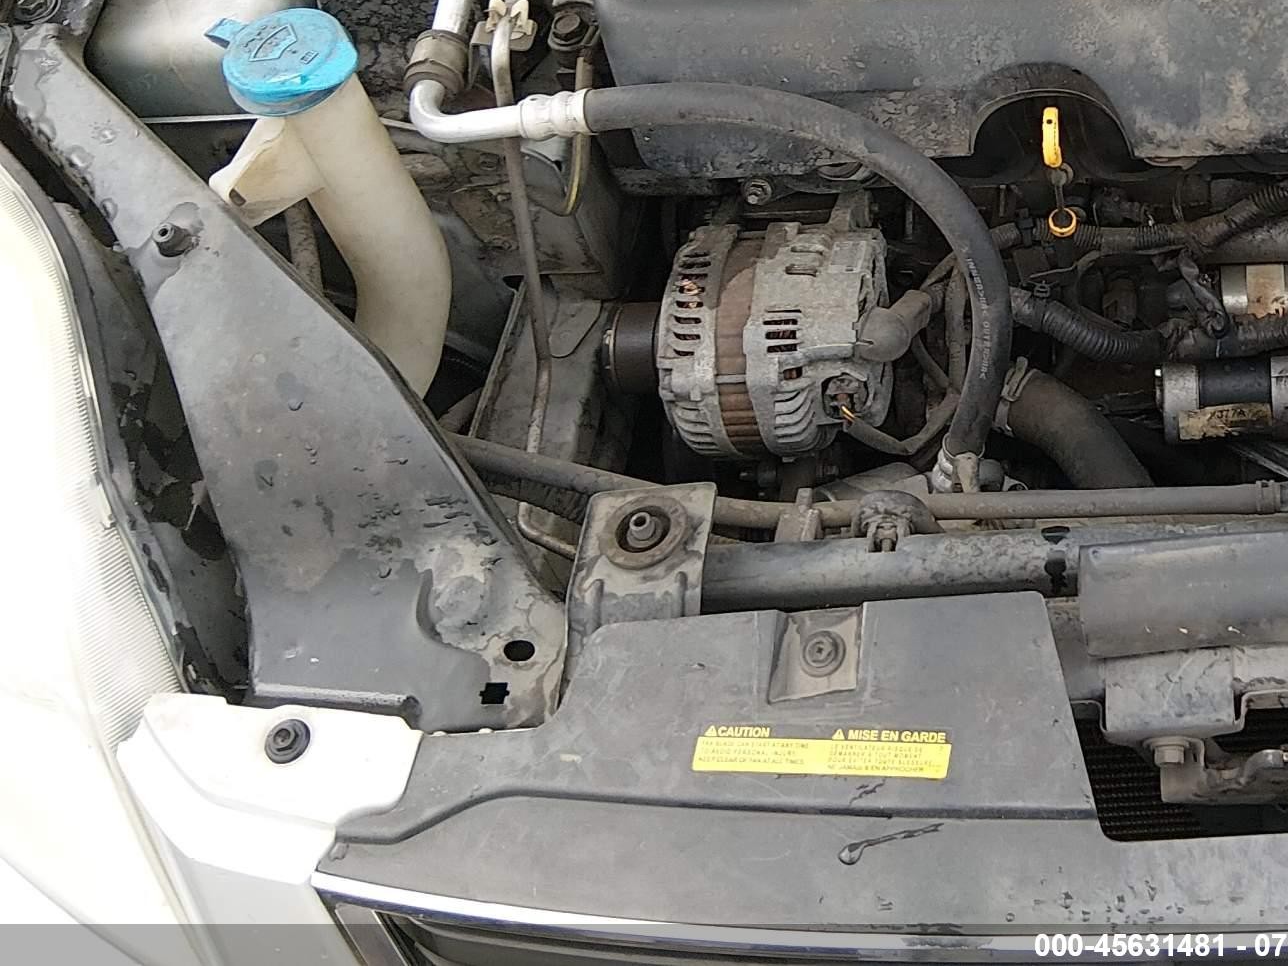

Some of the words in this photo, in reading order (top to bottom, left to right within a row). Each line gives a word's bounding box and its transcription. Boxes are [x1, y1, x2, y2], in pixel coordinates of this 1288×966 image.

[717, 727, 770, 738] CAUTION
[847, 729, 878, 740] MISE
[881, 730, 900, 741] EN
[901, 731, 946, 743] GARDE
